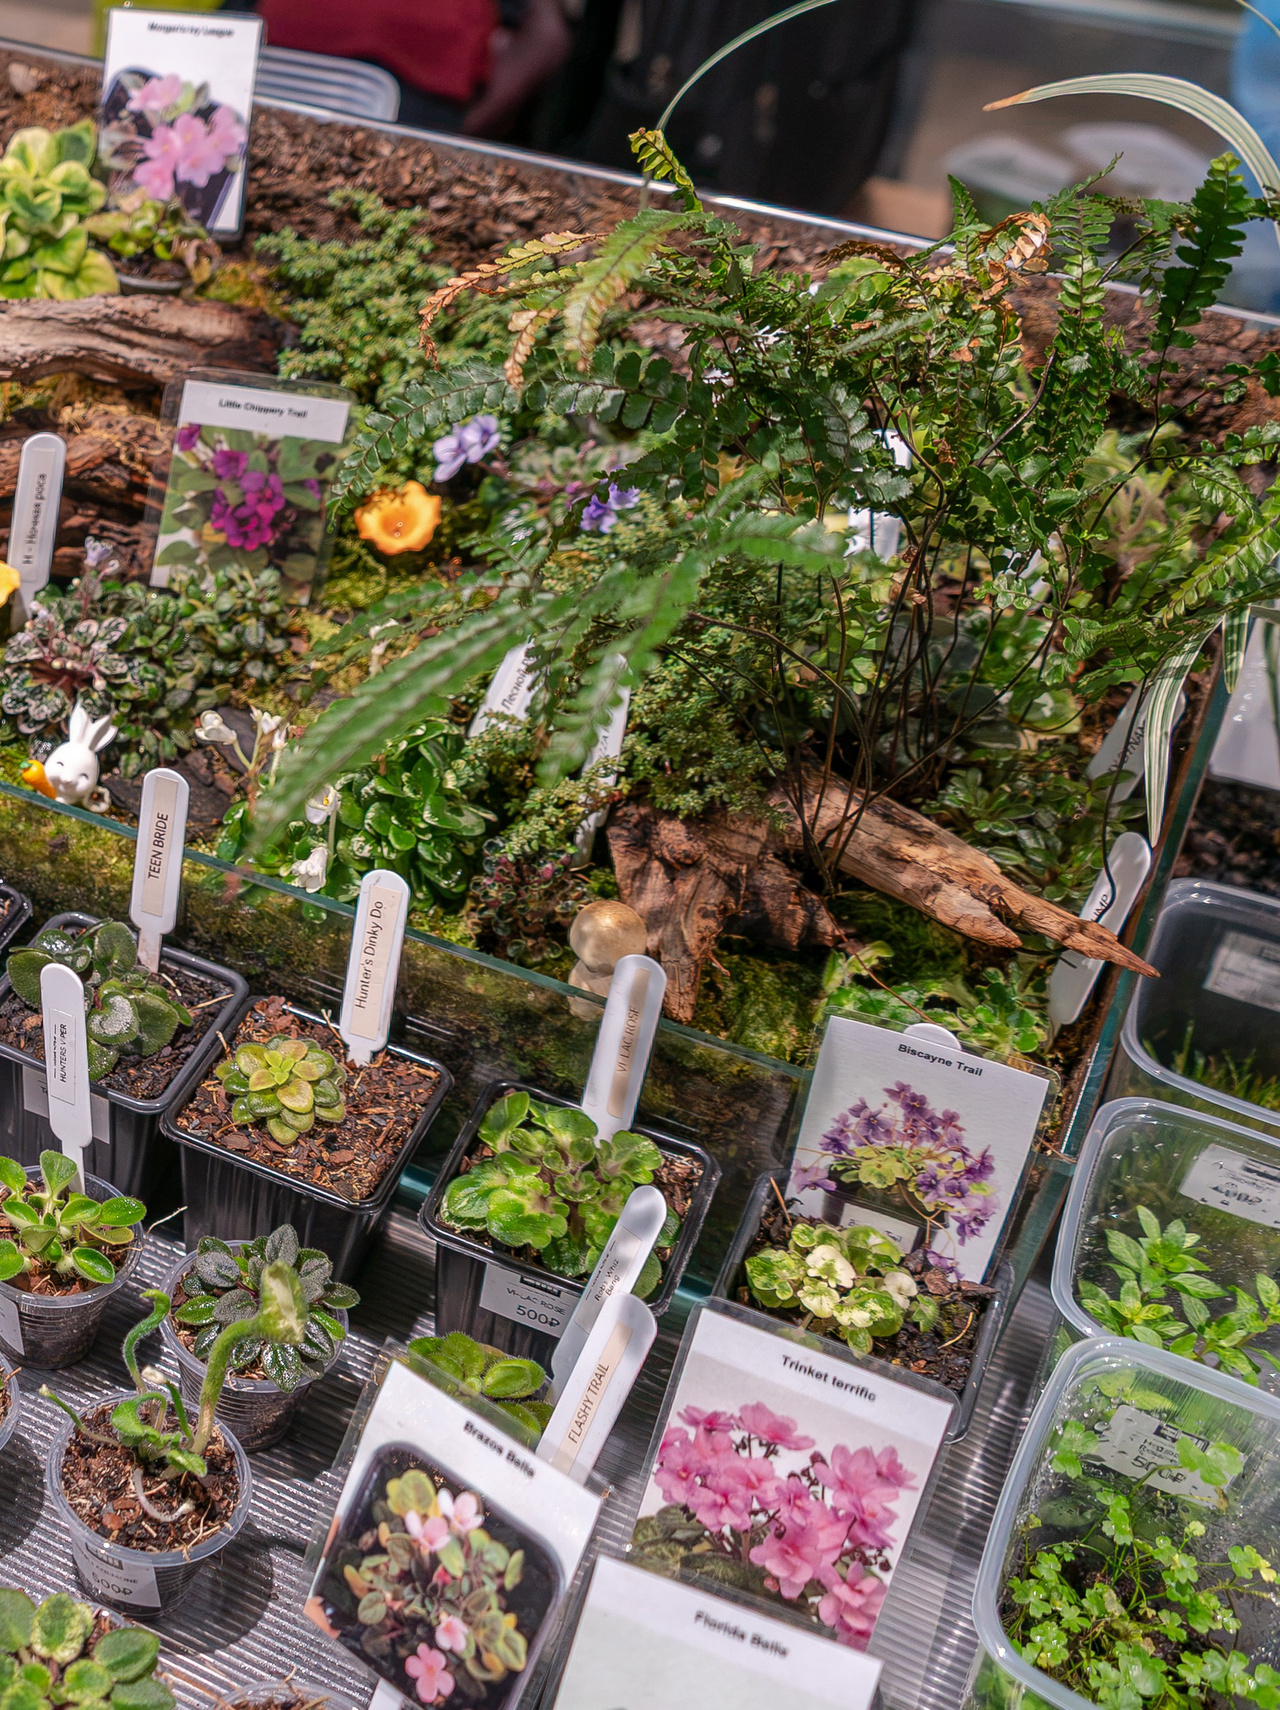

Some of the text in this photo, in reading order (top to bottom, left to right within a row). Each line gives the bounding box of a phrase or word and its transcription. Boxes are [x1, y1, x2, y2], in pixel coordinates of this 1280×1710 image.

[218, 399, 241, 409] Little
[148, 812, 169, 879] TEEN BRIDE
[355, 901, 384, 1009] Hunter's Dinky Do
[898, 1043, 983, 1077] Biscayne Trail
[605, 1274, 621, 1296] Bang
[540, 1300, 566, 1316] ROSE
[781, 1354, 877, 1402] Trinket terrific
[567, 1364, 610, 1444] FLASHY TRAIL
[463, 1420, 503, 1455] Brazos
[694, 1610, 746, 1641] Florida
